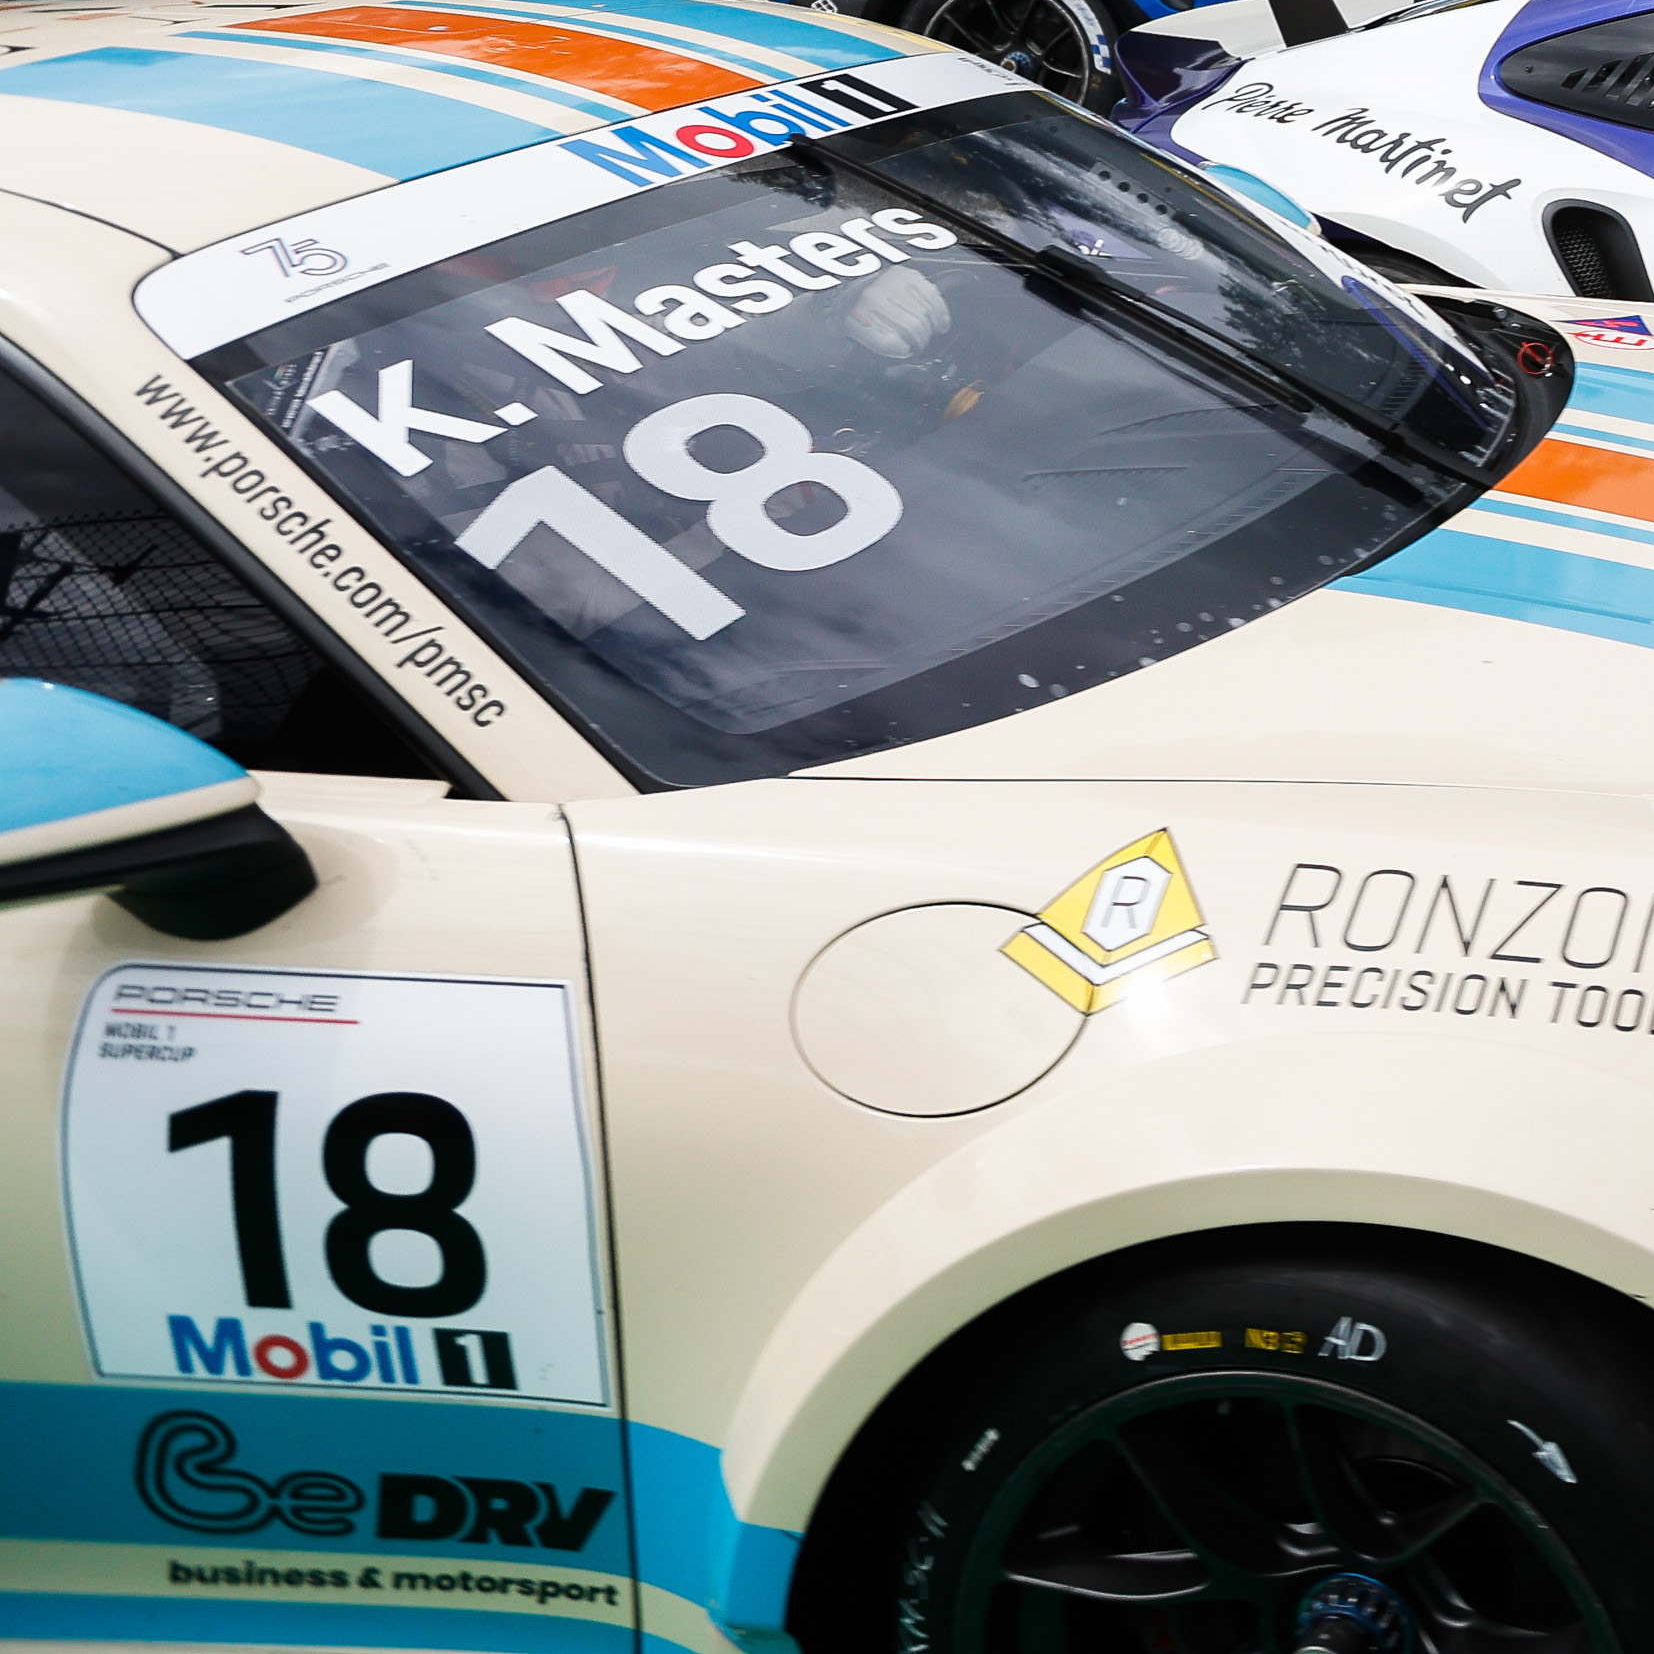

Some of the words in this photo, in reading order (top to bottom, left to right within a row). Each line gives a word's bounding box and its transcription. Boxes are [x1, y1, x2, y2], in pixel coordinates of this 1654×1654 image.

[556, 87, 855, 190] Mobil
[1202, 82, 1313, 126] Pierre
[1315, 106, 1521, 224] Martinet
[307, 359, 538, 478] K.
[484, 206, 960, 396] Masters
[133, 374, 509, 729] www.porsche.com/pmsc
[455, 393, 904, 642] 18
[104, 1021, 160, 1042] MOBIL
[113, 982, 343, 1013] PORSCHE
[1241, 961, 1530, 1020] PRECISION
[98, 1042, 196, 1062] SUPERCUP
[167, 1089, 489, 1319] 18
[167, 1314, 420, 1386] Mobil
[169, 1559, 347, 1590] business
[357, 1561, 384, 1591] &
[390, 1568, 620, 1608] motorsport
